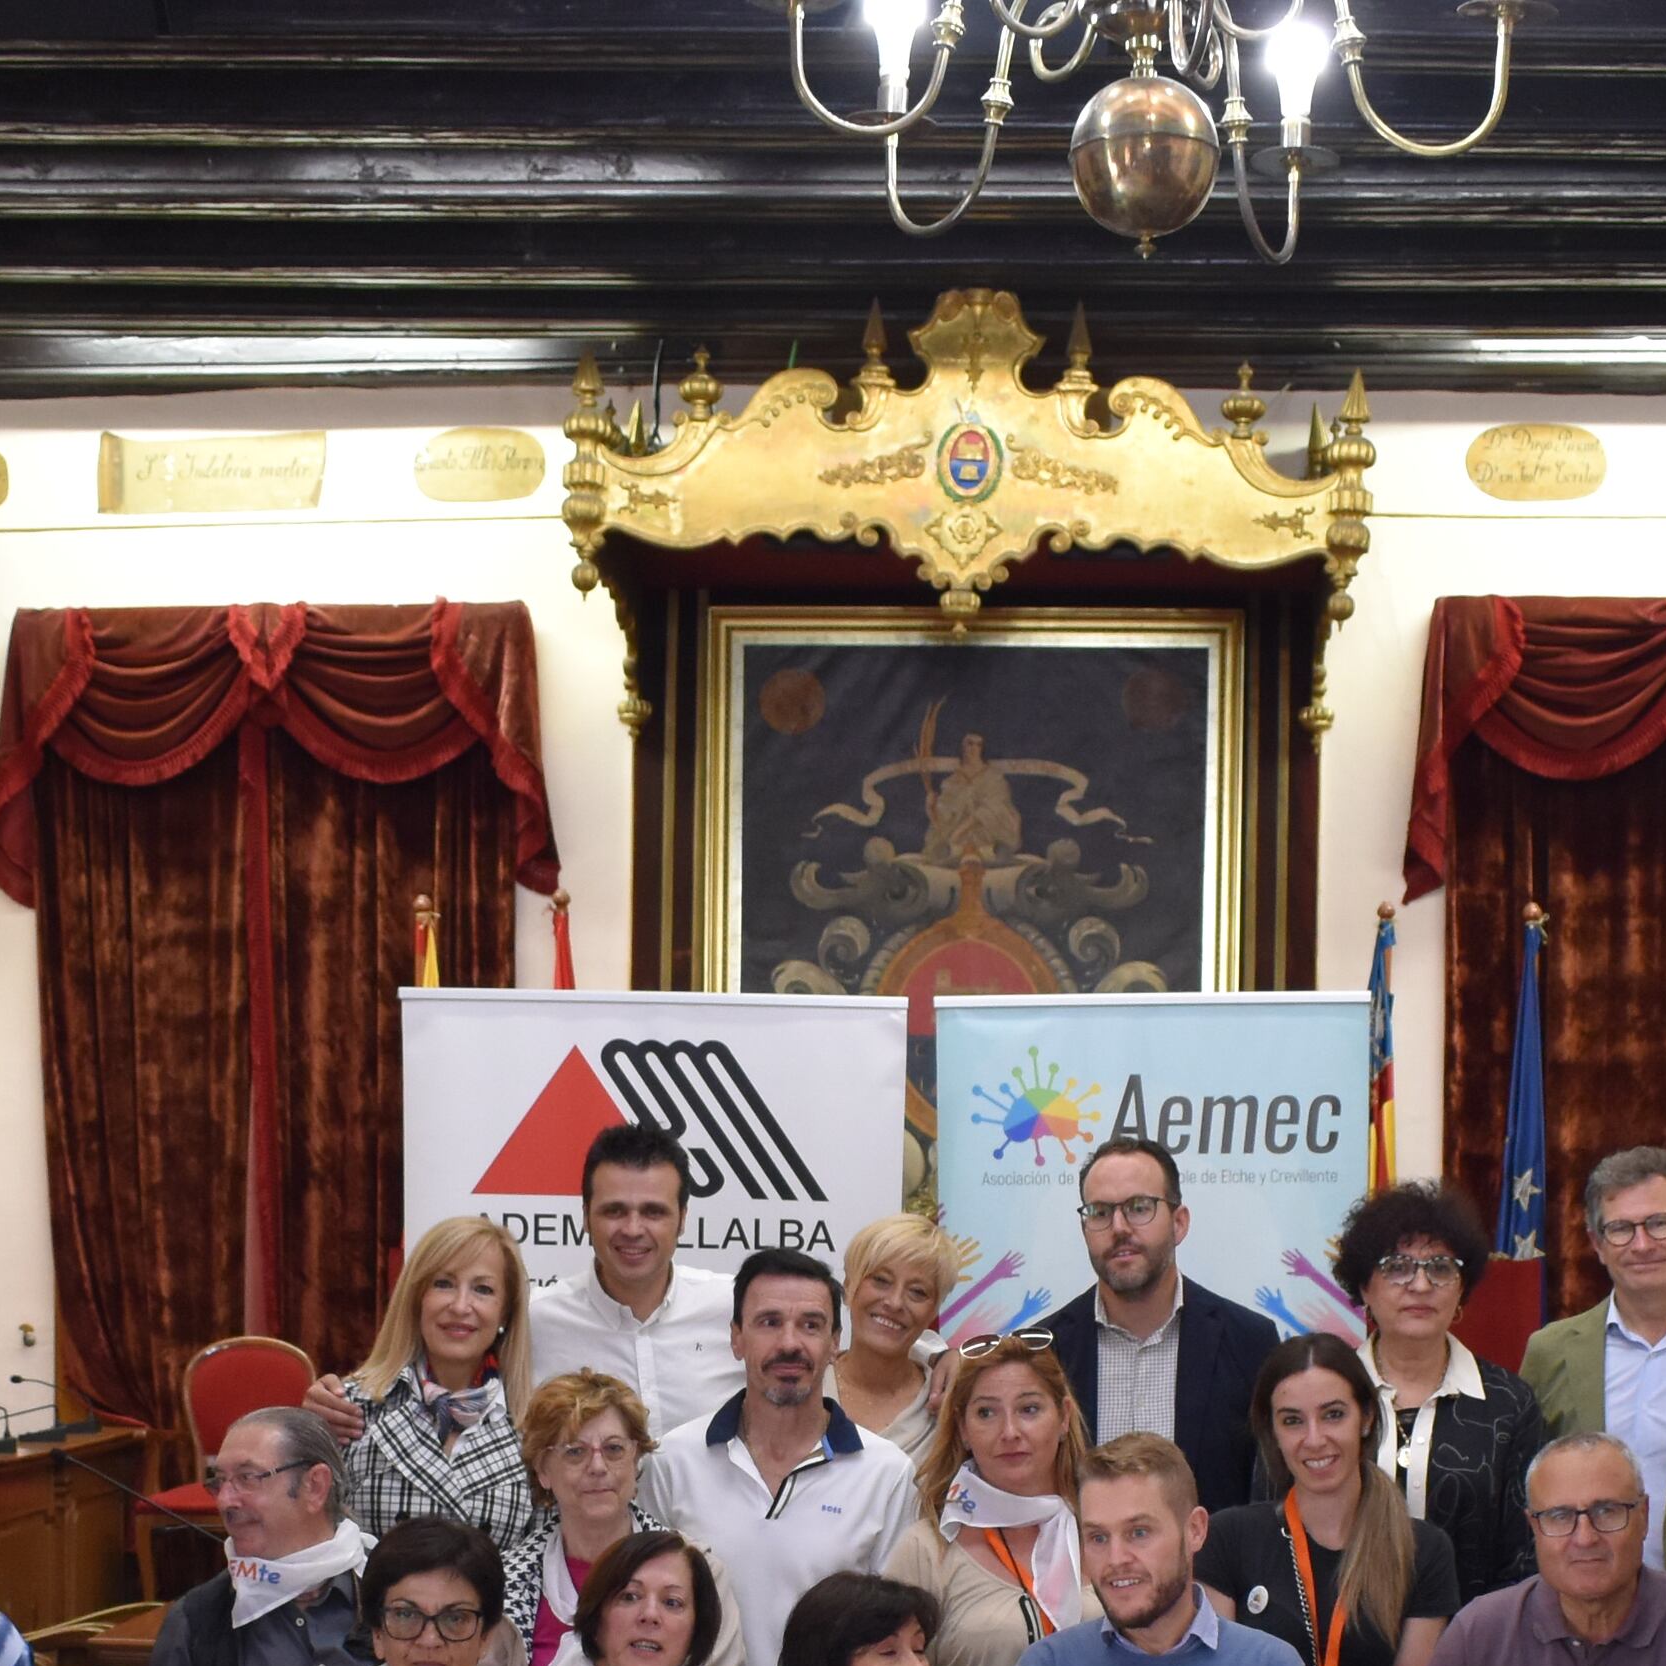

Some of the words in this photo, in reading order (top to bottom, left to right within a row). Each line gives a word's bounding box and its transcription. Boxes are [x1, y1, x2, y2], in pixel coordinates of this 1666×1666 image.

[1109, 1074, 1342, 1156] Aemec
[981, 1170, 1050, 1186] Asociación
[1058, 1171, 1074, 1185] de
[1200, 1169, 1217, 1184] de
[1221, 1169, 1256, 1184] Elche
[1270, 1169, 1339, 1184] Crevillente
